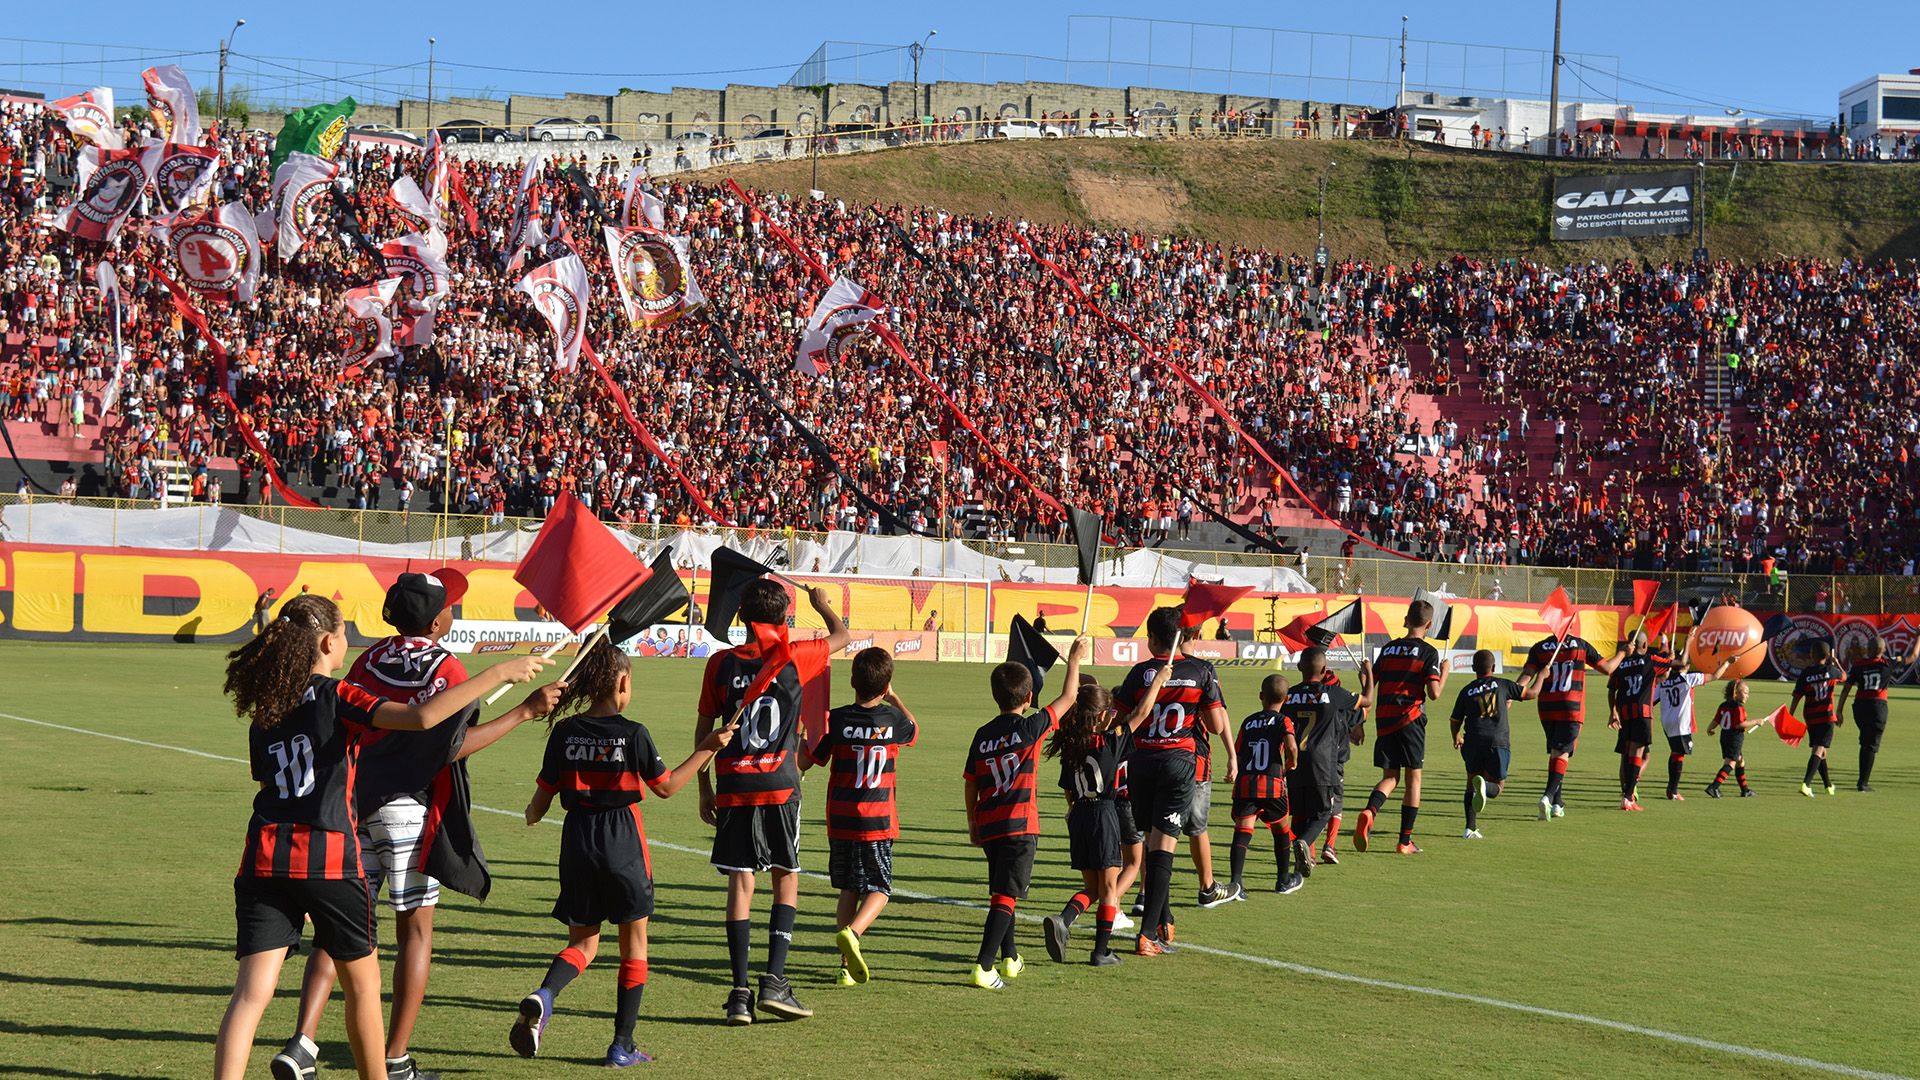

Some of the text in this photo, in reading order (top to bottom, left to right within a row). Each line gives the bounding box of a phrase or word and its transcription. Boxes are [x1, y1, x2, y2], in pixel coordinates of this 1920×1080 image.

[1555, 186, 1690, 210] CAIXA
[1577, 209, 1688, 221] PATROCINADOR MASTER
[1590, 219, 1626, 228] ESPORTE
[1657, 215, 1689, 224] VITÓRIA
[480, 630, 528, 642] CONTRA
[1699, 631, 1745, 648] SCHIN
[846, 639, 872, 652] SCHIN
[895, 639, 921, 653] SCHIN
[1113, 642, 1138, 662] G1
[1383, 645, 1420, 657] CAIXA
[1550, 660, 1575, 693] 10
[1863, 673, 1881, 690] 10
[1467, 680, 1499, 697] CAIXA
[1148, 702, 1186, 738] 10
[1245, 716, 1276, 731] CAIXA
[842, 726, 893, 740] CAIXA
[1297, 710, 1317, 751] 7
[599, 738, 626, 746] KETLIN
[979, 731, 1022, 754] CAIXA
[565, 745, 625, 762] CAIXA
[1246, 738, 1270, 771] 10
[267, 732, 316, 799] 10
[851, 745, 887, 789] 10
[985, 752, 1021, 798] 10
